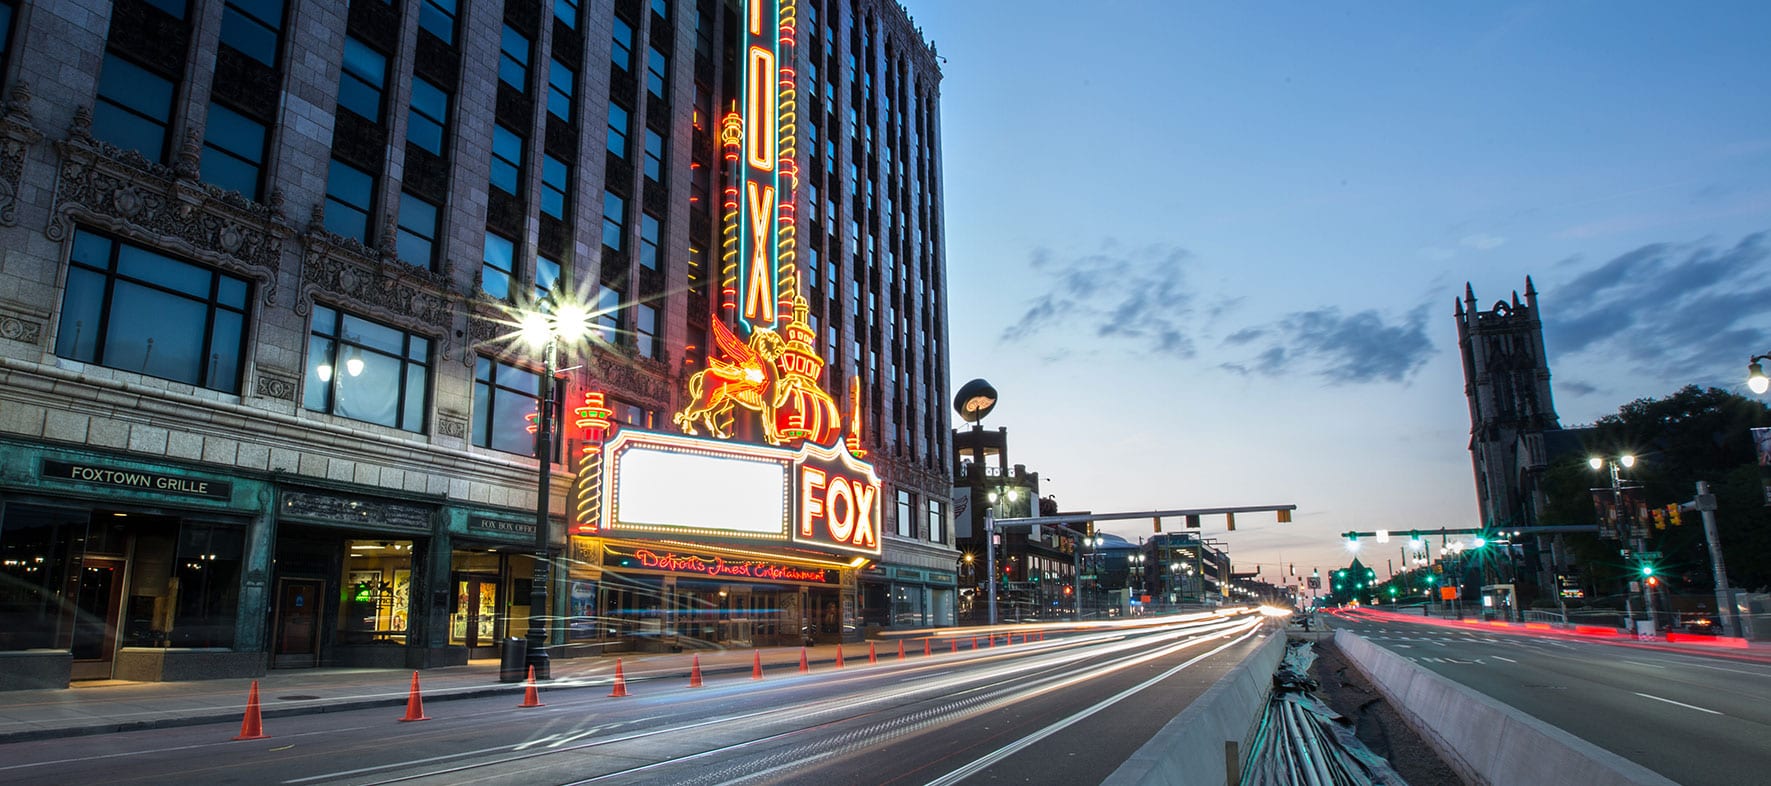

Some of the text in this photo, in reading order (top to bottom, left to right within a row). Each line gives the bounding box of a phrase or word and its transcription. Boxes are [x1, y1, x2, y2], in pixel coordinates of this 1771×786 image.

[72, 466, 208, 493] FOXTOWN GRILLE
[801, 464, 876, 547] FOX
[481, 520, 537, 533] FOX BOX OFFIC
[634, 548, 826, 583] Detroit's Finest Entertainment
